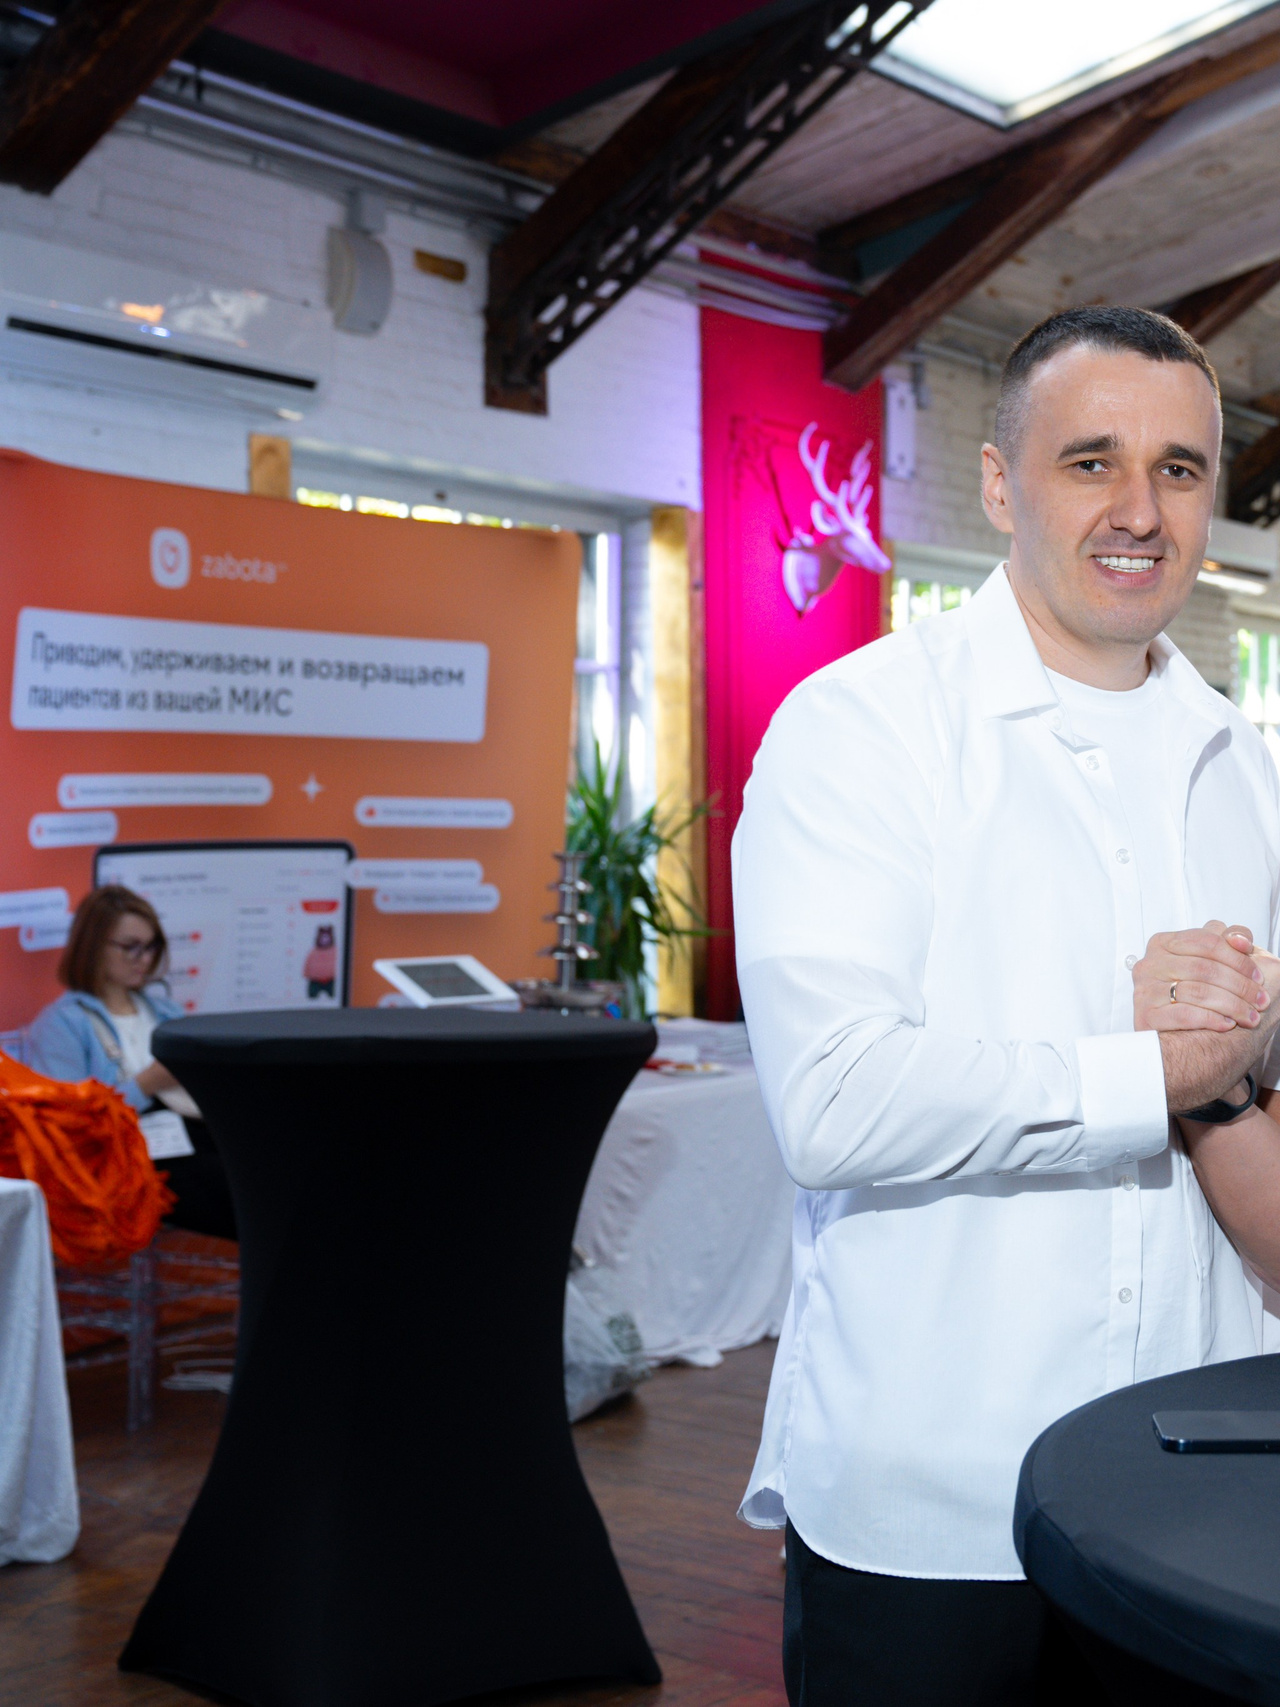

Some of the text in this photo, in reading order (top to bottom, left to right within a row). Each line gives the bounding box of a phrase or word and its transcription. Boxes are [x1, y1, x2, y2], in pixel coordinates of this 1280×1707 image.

[201, 552, 277, 584] zabota
[31, 631, 465, 690] Приводим, удерживаем и возвращаем
[28, 684, 294, 717] пациентов из вашей МИС
